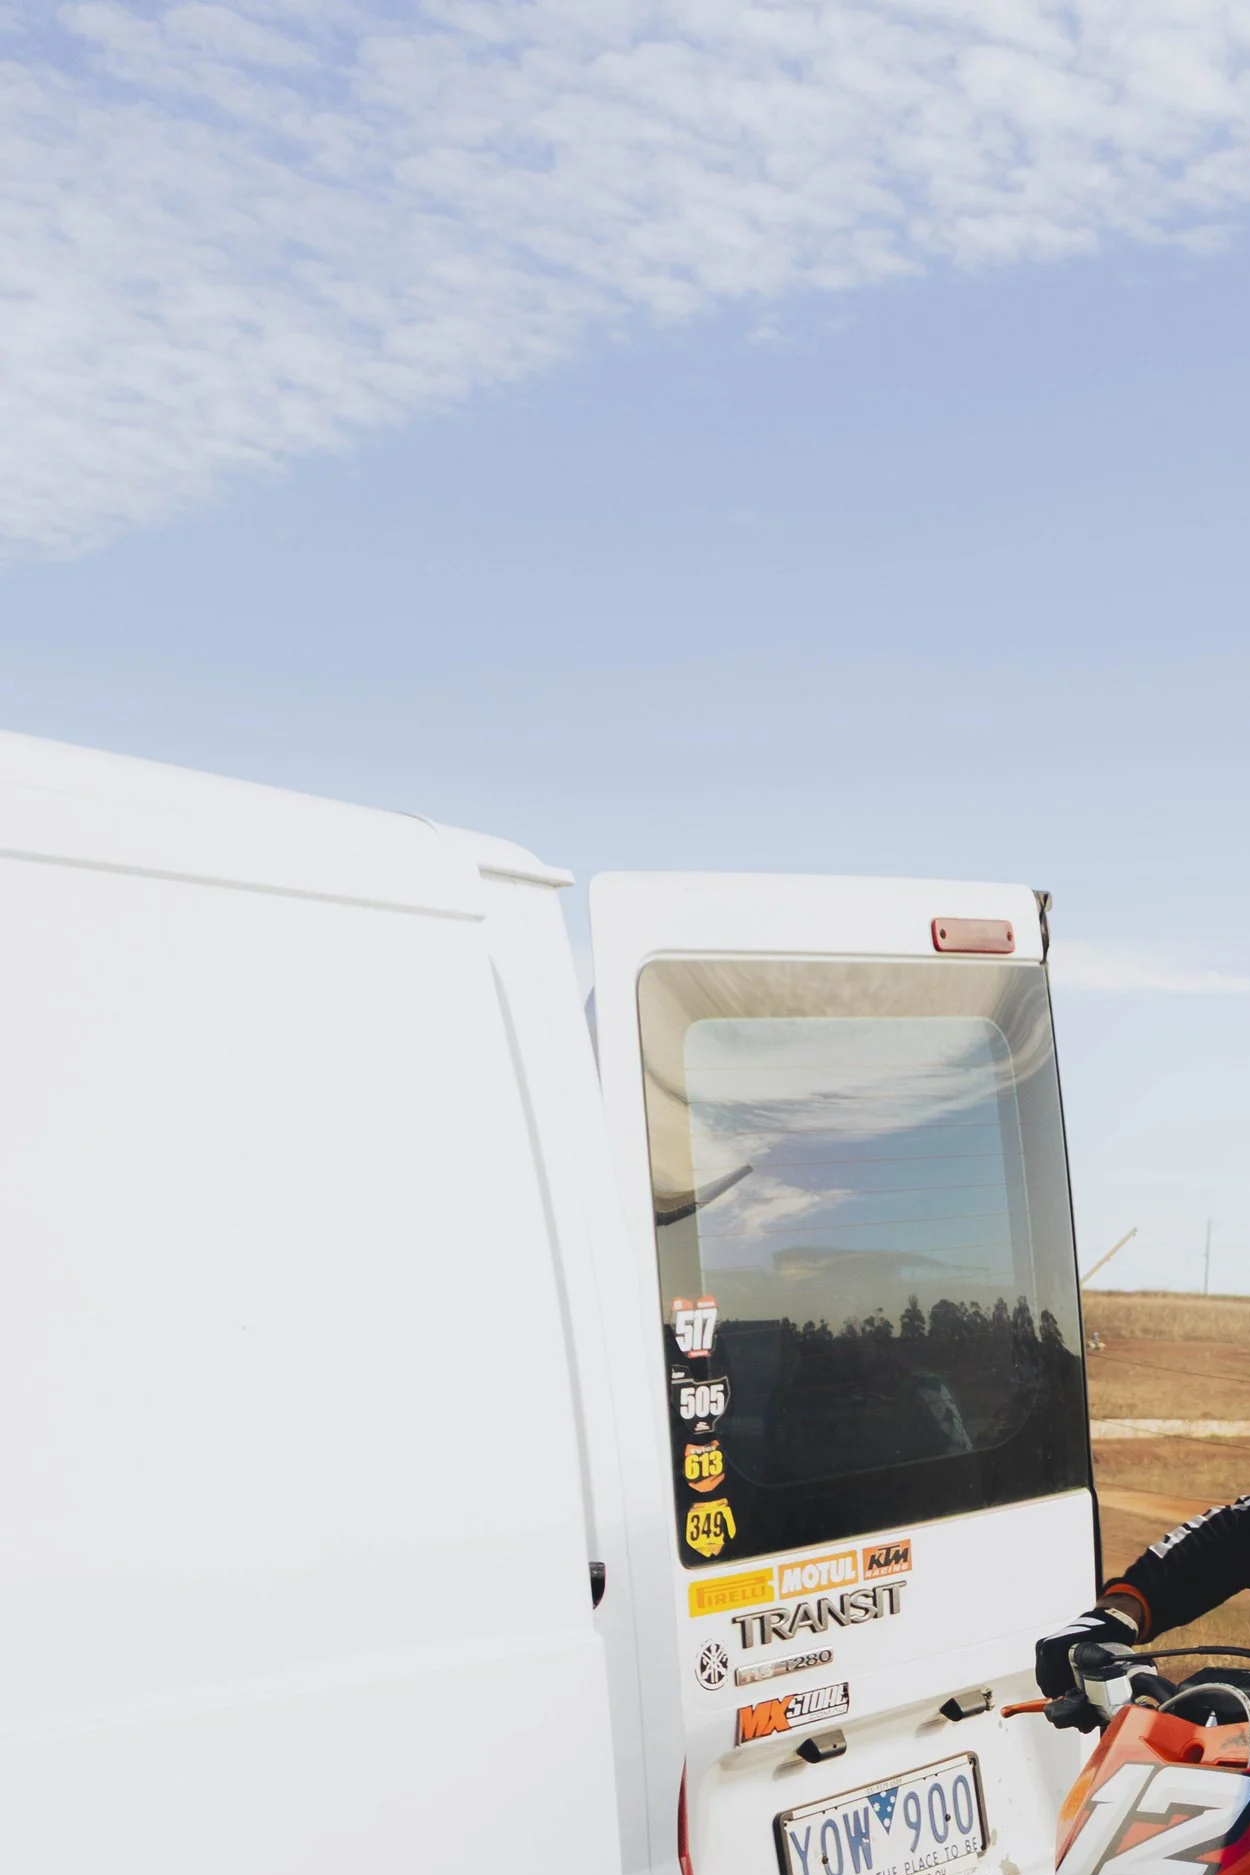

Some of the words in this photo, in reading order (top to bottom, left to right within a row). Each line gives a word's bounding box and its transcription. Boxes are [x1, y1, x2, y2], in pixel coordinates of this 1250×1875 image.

[675, 1308, 718, 1352] 517
[680, 1384, 725, 1419] 505
[684, 1450, 723, 1480] 613
[690, 1511, 724, 1541] 349
[864, 1562, 909, 1579] RACING
[868, 1544, 909, 1570] KTM
[696, 1575, 766, 1609] PIRELLI
[781, 1556, 857, 1594] MOTUL
[732, 1580, 907, 1649] TRANSIT
[780, 1650, 832, 1673] T280
[903, 1775, 973, 1853] 900
[904, 1851, 939, 1875] PLACE
[944, 1844, 959, 1862] TO
[965, 1837, 978, 1854] BE
